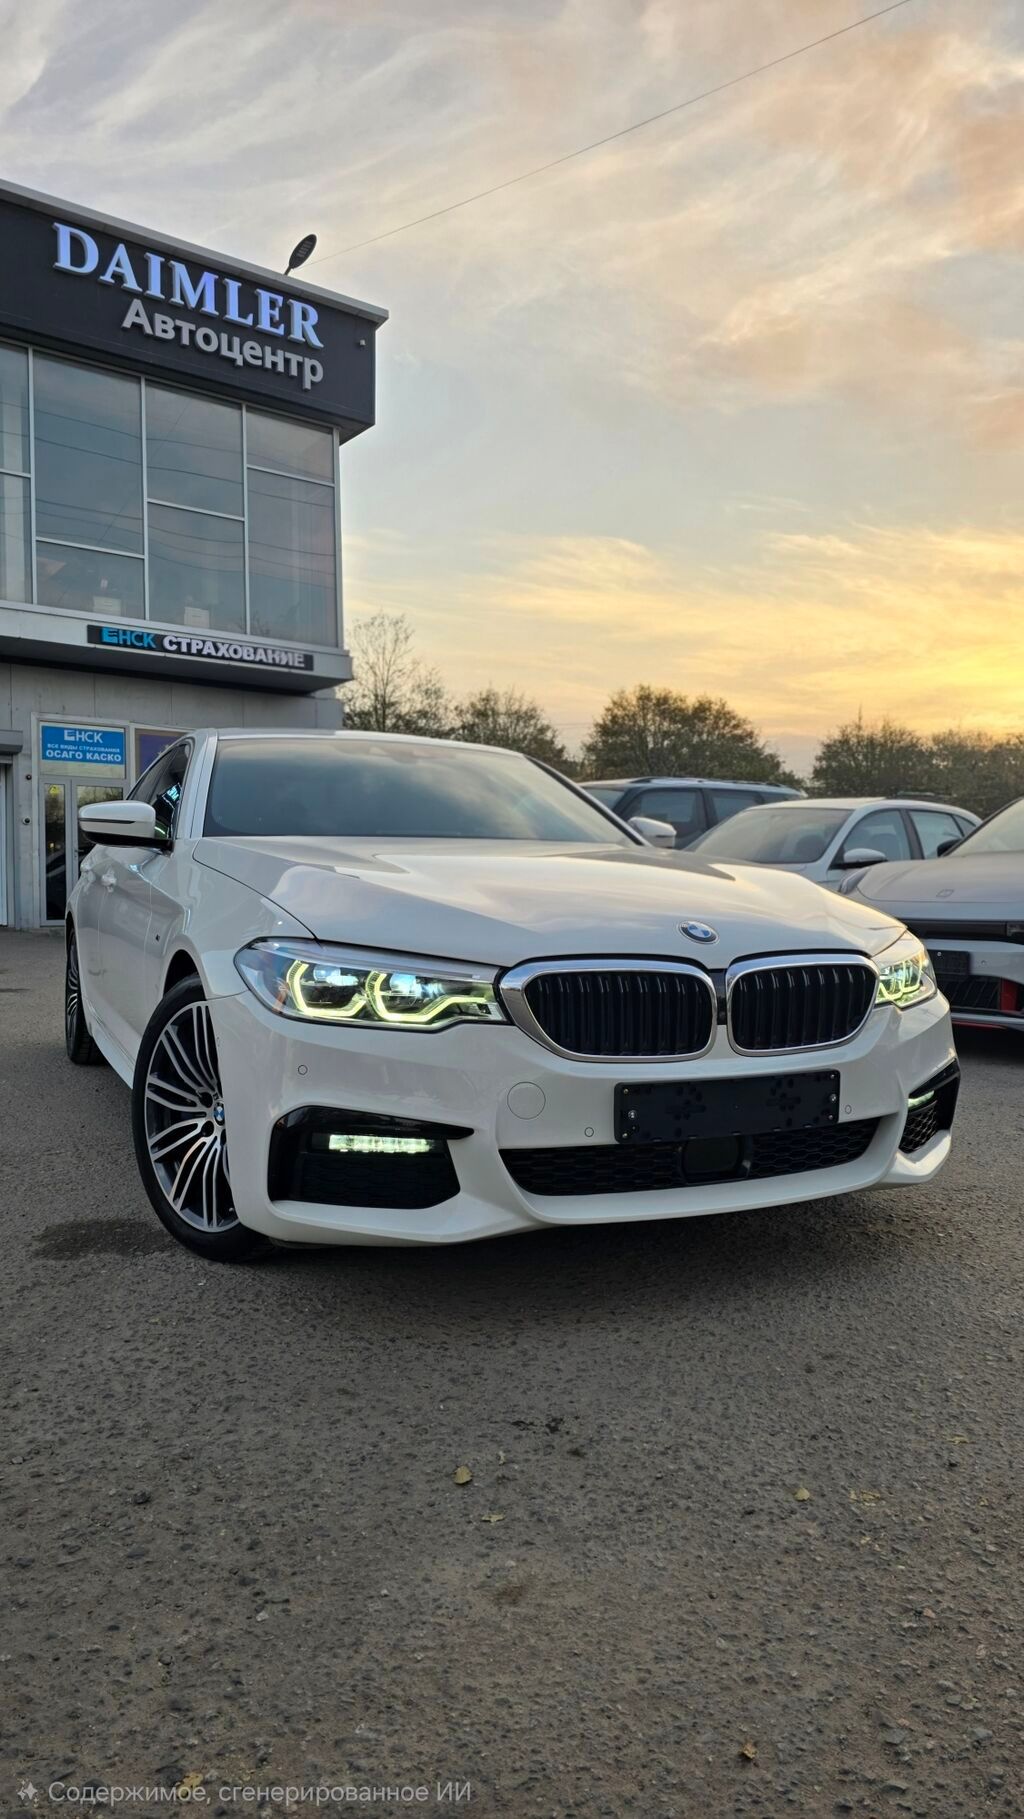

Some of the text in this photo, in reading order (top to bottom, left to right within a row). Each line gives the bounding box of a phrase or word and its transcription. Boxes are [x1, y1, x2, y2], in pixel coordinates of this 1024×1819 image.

[52, 221, 324, 349] DAIMLER
[121, 299, 324, 390] Автоцентр
[162, 635, 305, 667] СТРАХОВАНИЕ
[46, 750, 122, 762] ОСАГО КАСКО
